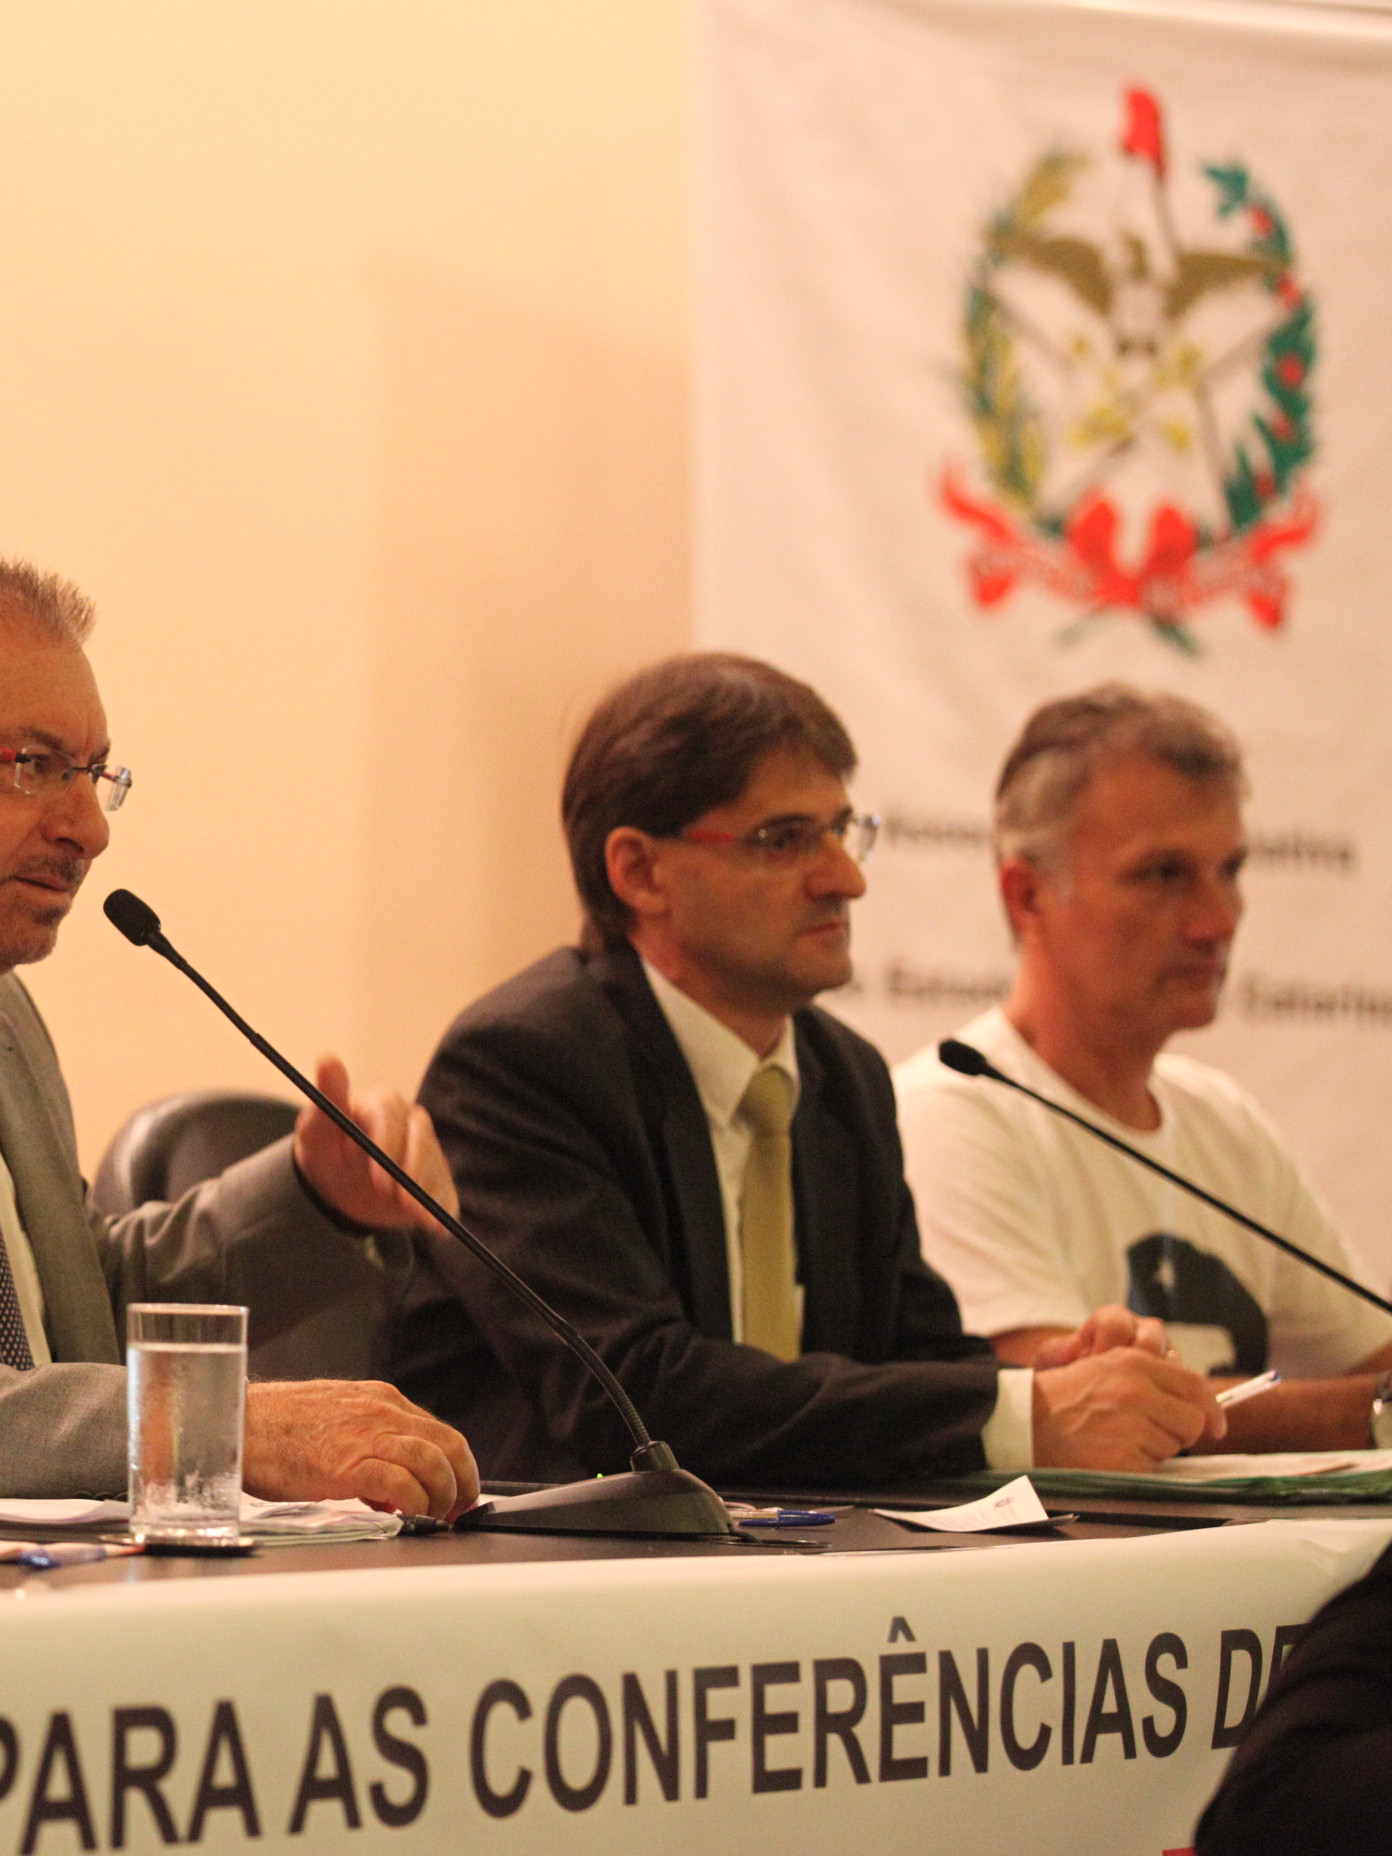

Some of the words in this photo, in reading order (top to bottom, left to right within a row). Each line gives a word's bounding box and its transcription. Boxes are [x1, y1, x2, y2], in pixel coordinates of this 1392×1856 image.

[289, 1685, 430, 1834] AS
[469, 1616, 1188, 1819] CONFERÊNCIAS
[1211, 1623, 1310, 1750] D
